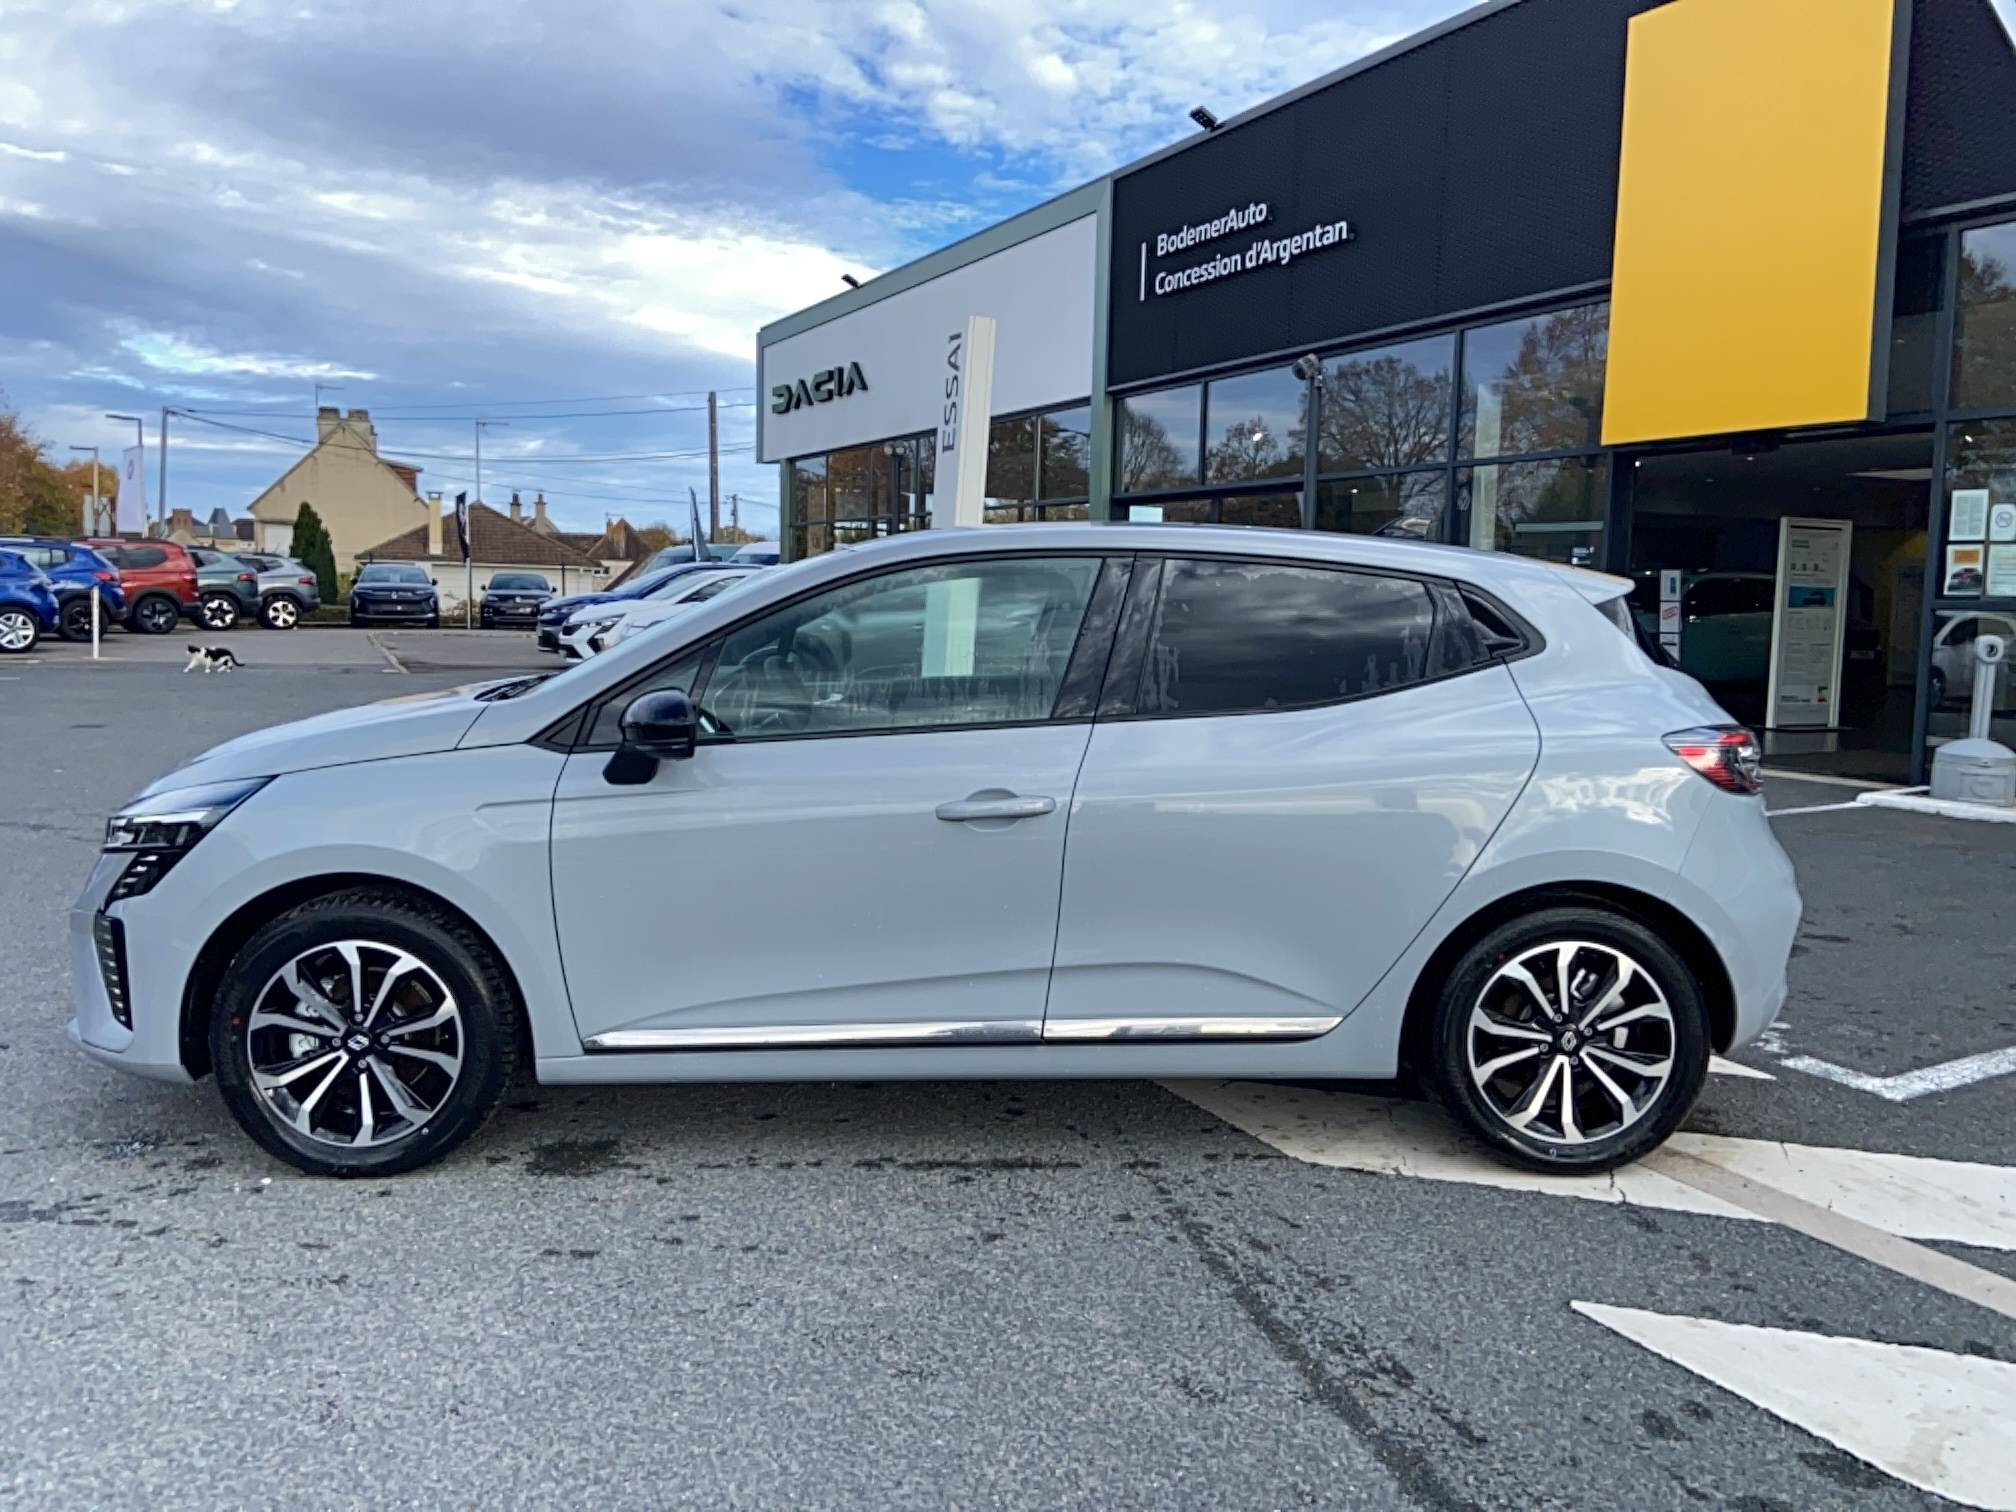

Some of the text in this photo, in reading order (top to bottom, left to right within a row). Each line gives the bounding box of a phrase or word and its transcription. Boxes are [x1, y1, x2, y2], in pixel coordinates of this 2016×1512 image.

[1154, 220, 1349, 296] Concession d'Argentan
[1156, 202, 1268, 257] BodemerAuto
[771, 361, 869, 414] DACIA
[942, 332, 963, 454] ESSAI
